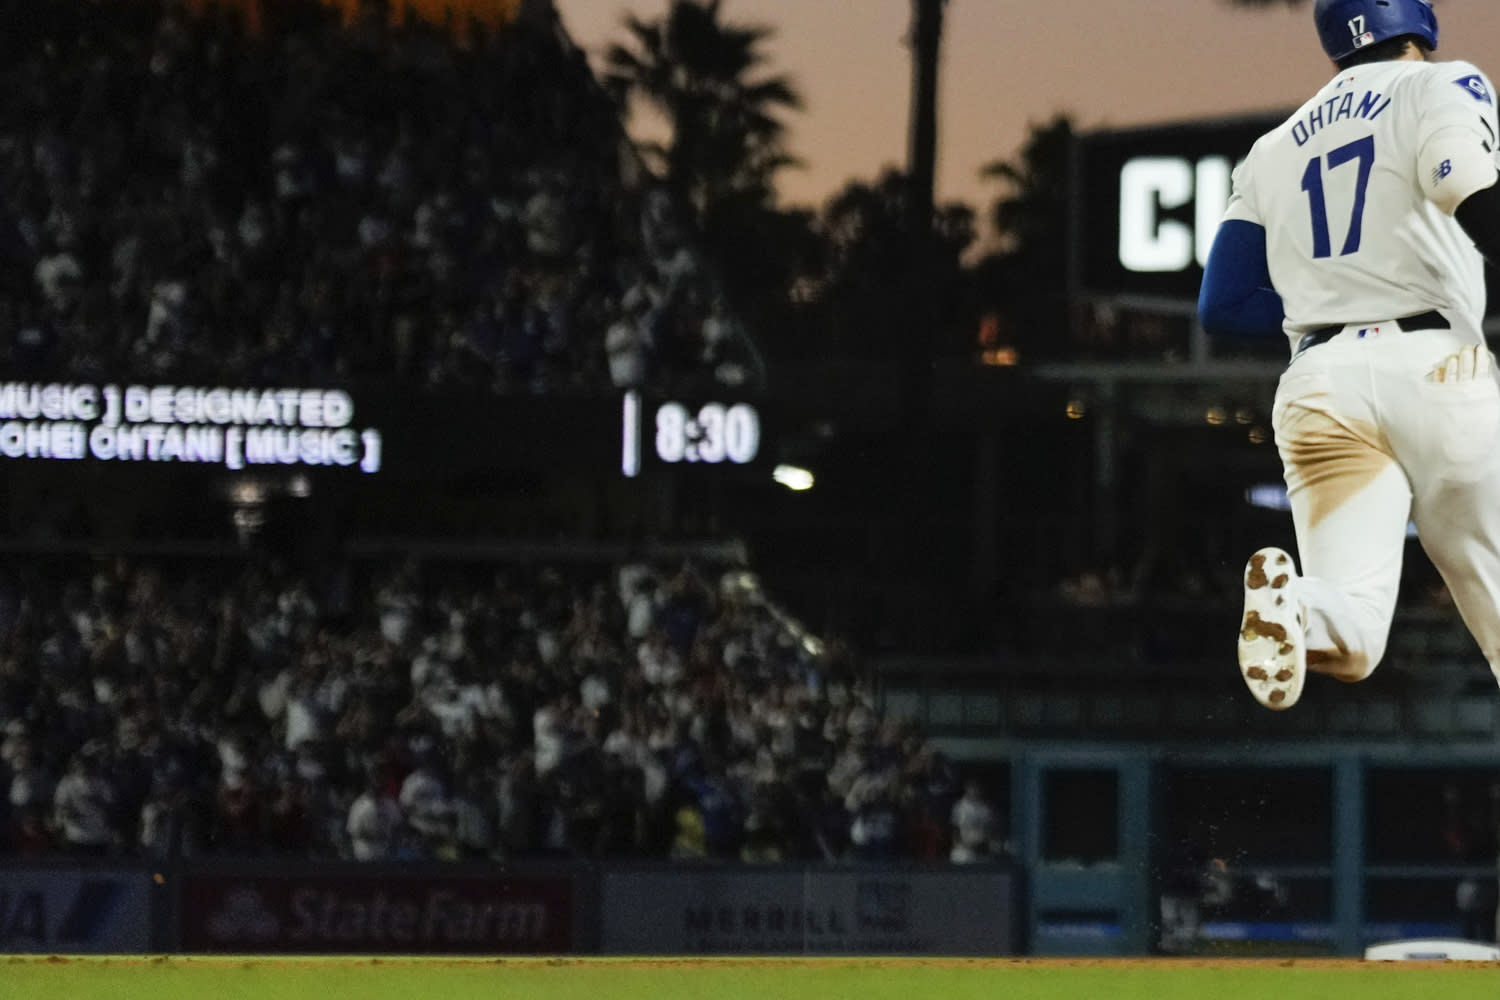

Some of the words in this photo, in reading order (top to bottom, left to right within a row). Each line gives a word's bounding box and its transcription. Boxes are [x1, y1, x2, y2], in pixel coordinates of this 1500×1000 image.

[1347, 15, 1365, 36] 17
[1292, 90, 1391, 147] OHTANI
[1301, 134, 1375, 258] 17
[125, 385, 352, 427] DESIGNATED
[0, 421, 87, 459] OHEI
[90, 423, 224, 462] OHTANI
[246, 426, 358, 465] MUSIC
[655, 402, 760, 464] 8:30
[684, 905, 847, 935] MERRILL
